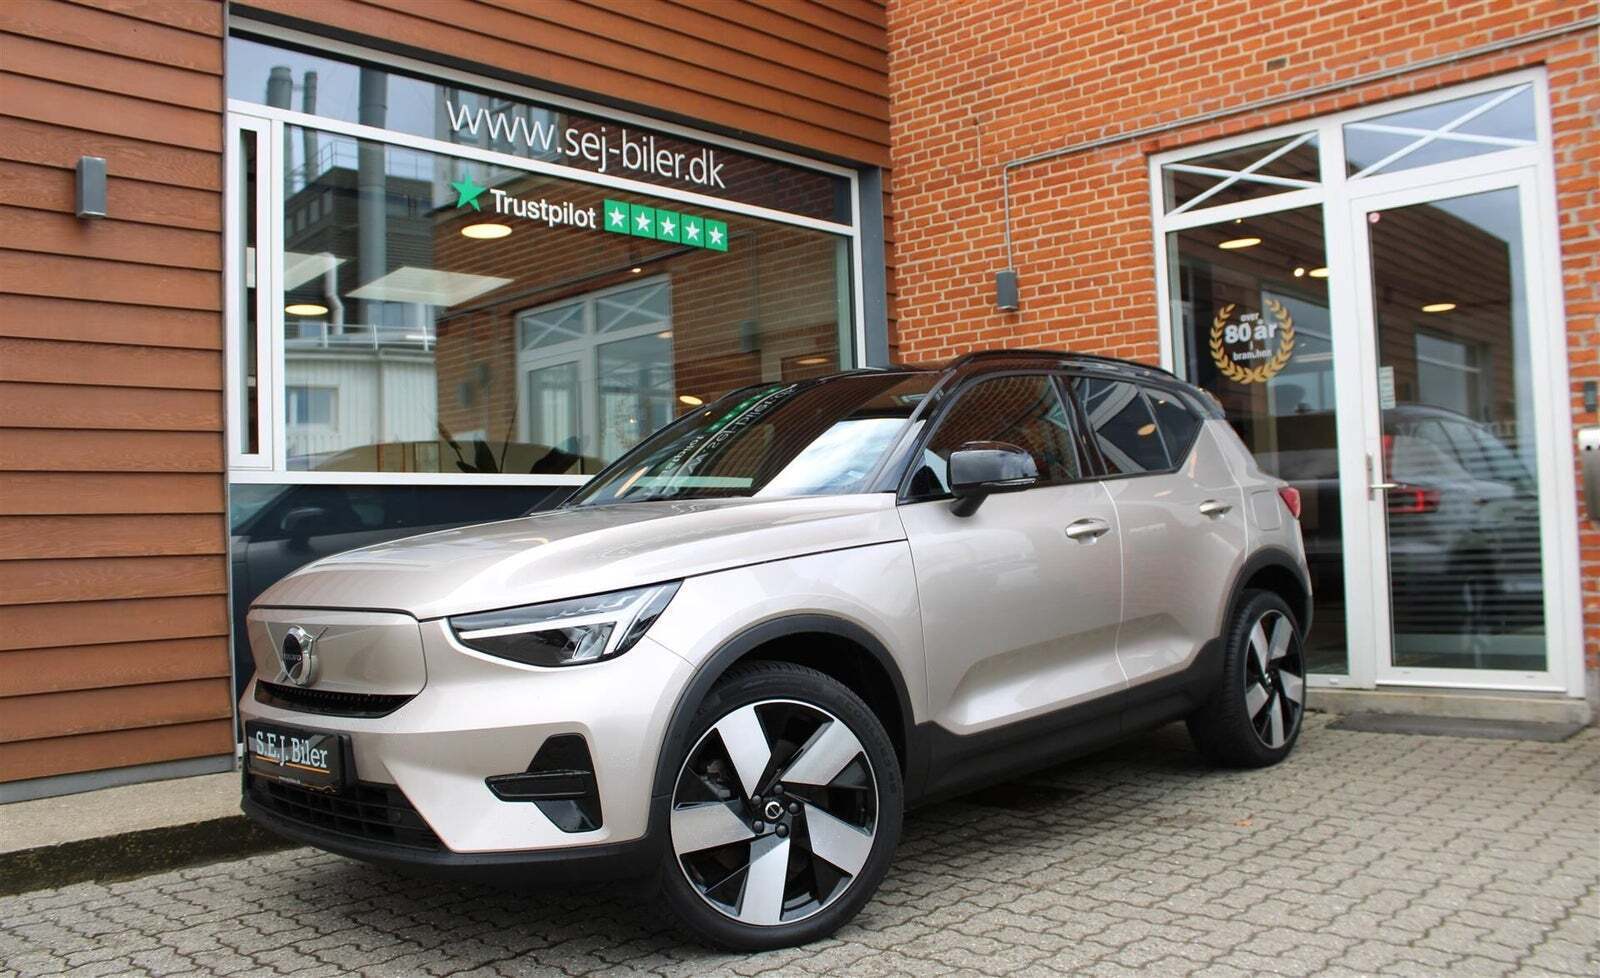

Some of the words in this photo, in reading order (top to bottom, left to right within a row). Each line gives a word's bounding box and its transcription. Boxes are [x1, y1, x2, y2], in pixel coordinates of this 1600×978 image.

[446, 100, 726, 190] www.sej-biler.dk
[489, 188, 597, 229] Trustpilot
[1225, 322, 1252, 343] 80
[1254, 319, 1278, 339] år
[255, 731, 288, 767] S.E.J.
[291, 737, 328, 768] Biler
